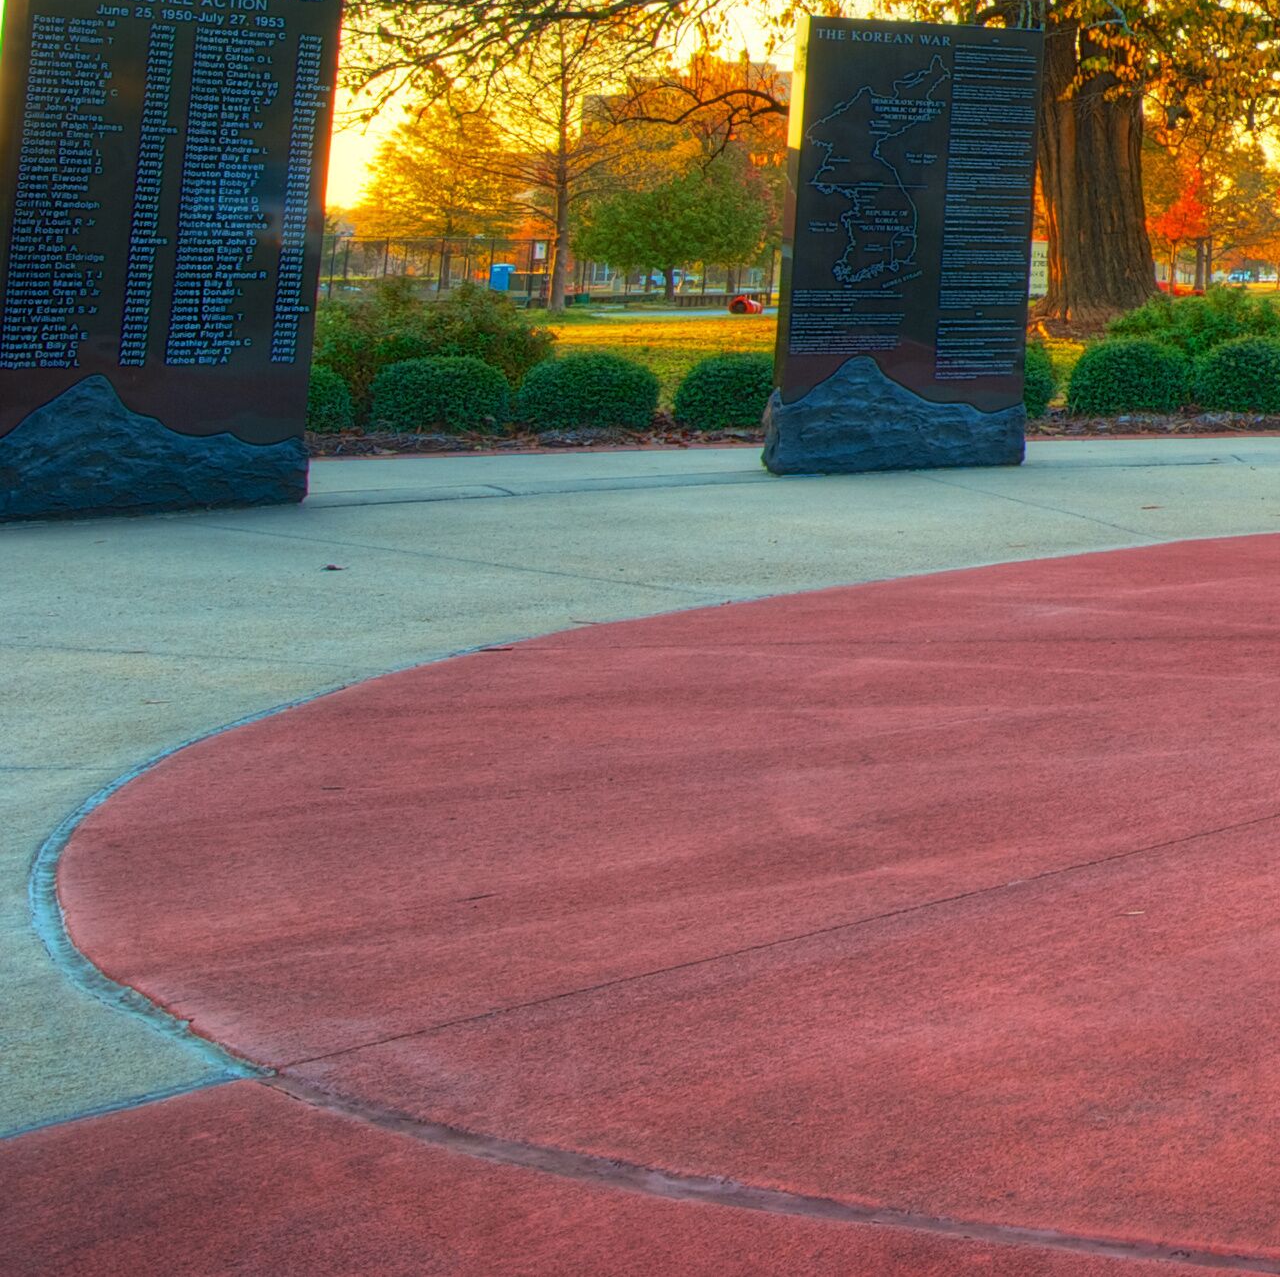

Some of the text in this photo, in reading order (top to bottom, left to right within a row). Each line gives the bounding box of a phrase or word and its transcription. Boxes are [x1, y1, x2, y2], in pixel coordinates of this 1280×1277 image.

[96, 5, 128, 18] June
[162, 9, 223, 27] 1950-July
[255, 16, 285, 28] 1953
[151, 24, 176, 34] Army
[816, 29, 951, 46] THE KOREAN WAR
[135, 203, 159, 212] Army
[278, 272, 302, 281] Army
[120, 349, 145, 358] Army
[271, 355, 295, 364] Army
